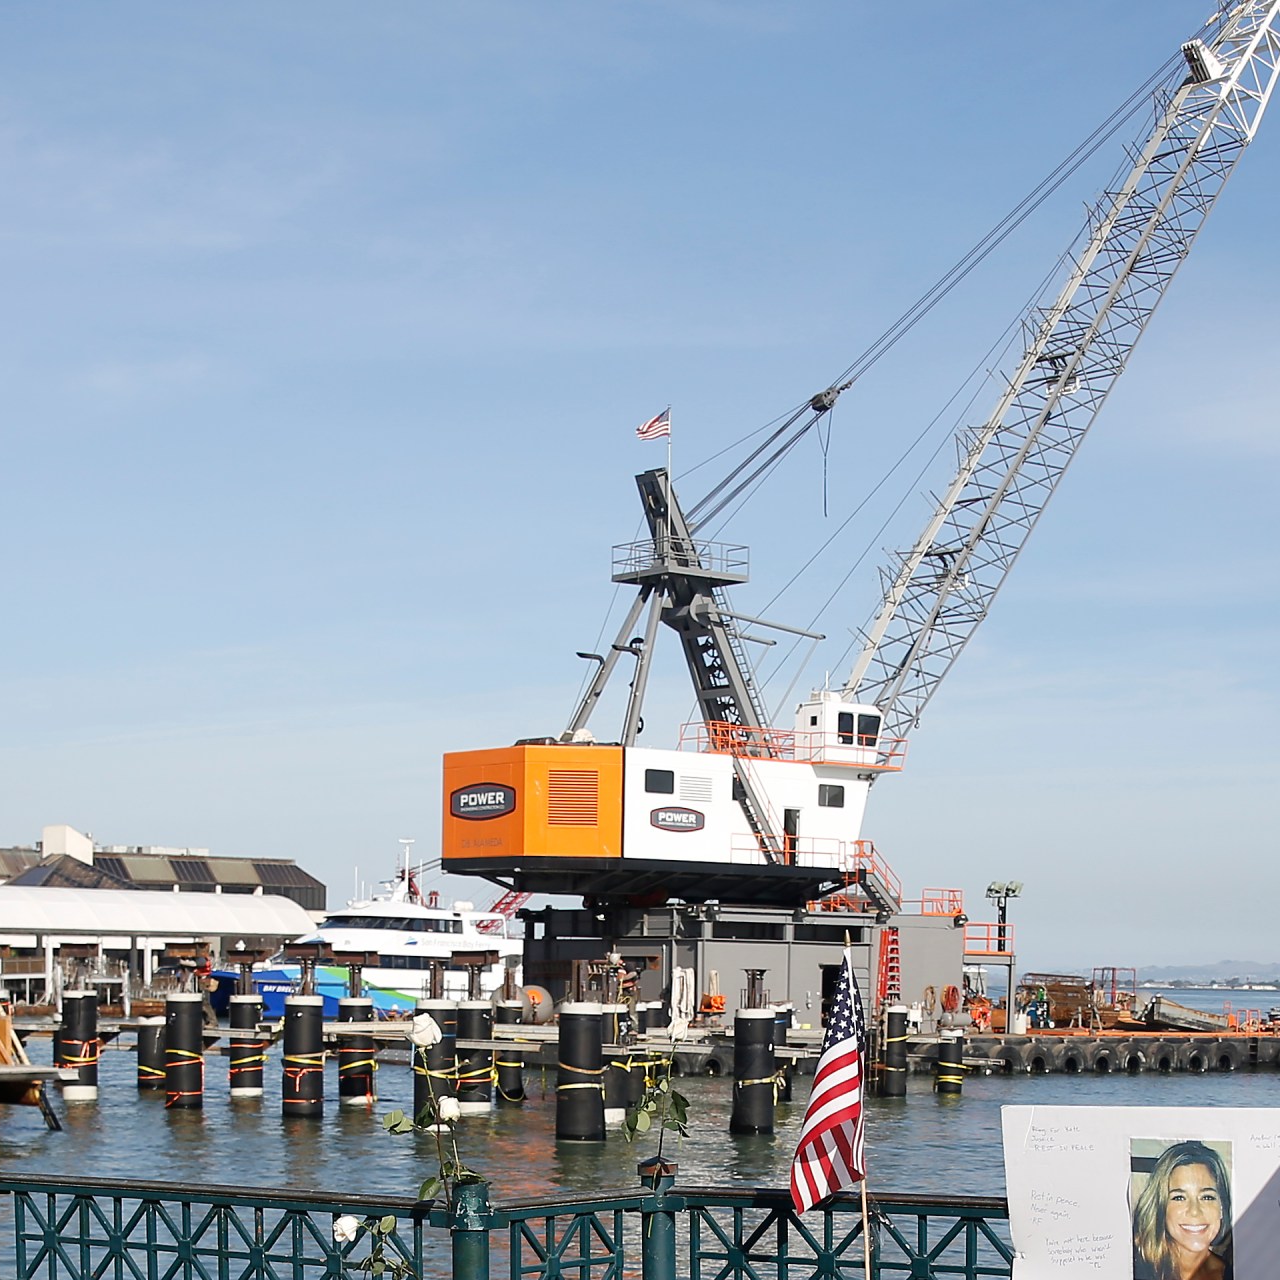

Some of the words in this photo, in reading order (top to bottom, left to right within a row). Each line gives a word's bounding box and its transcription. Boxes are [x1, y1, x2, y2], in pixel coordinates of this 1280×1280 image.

[460, 791, 505, 807] POWER
[658, 811, 697, 824] POWER
[421, 938, 432, 946] San
[462, 940, 474, 949] Bay
[1046, 1192, 1053, 1201] in
